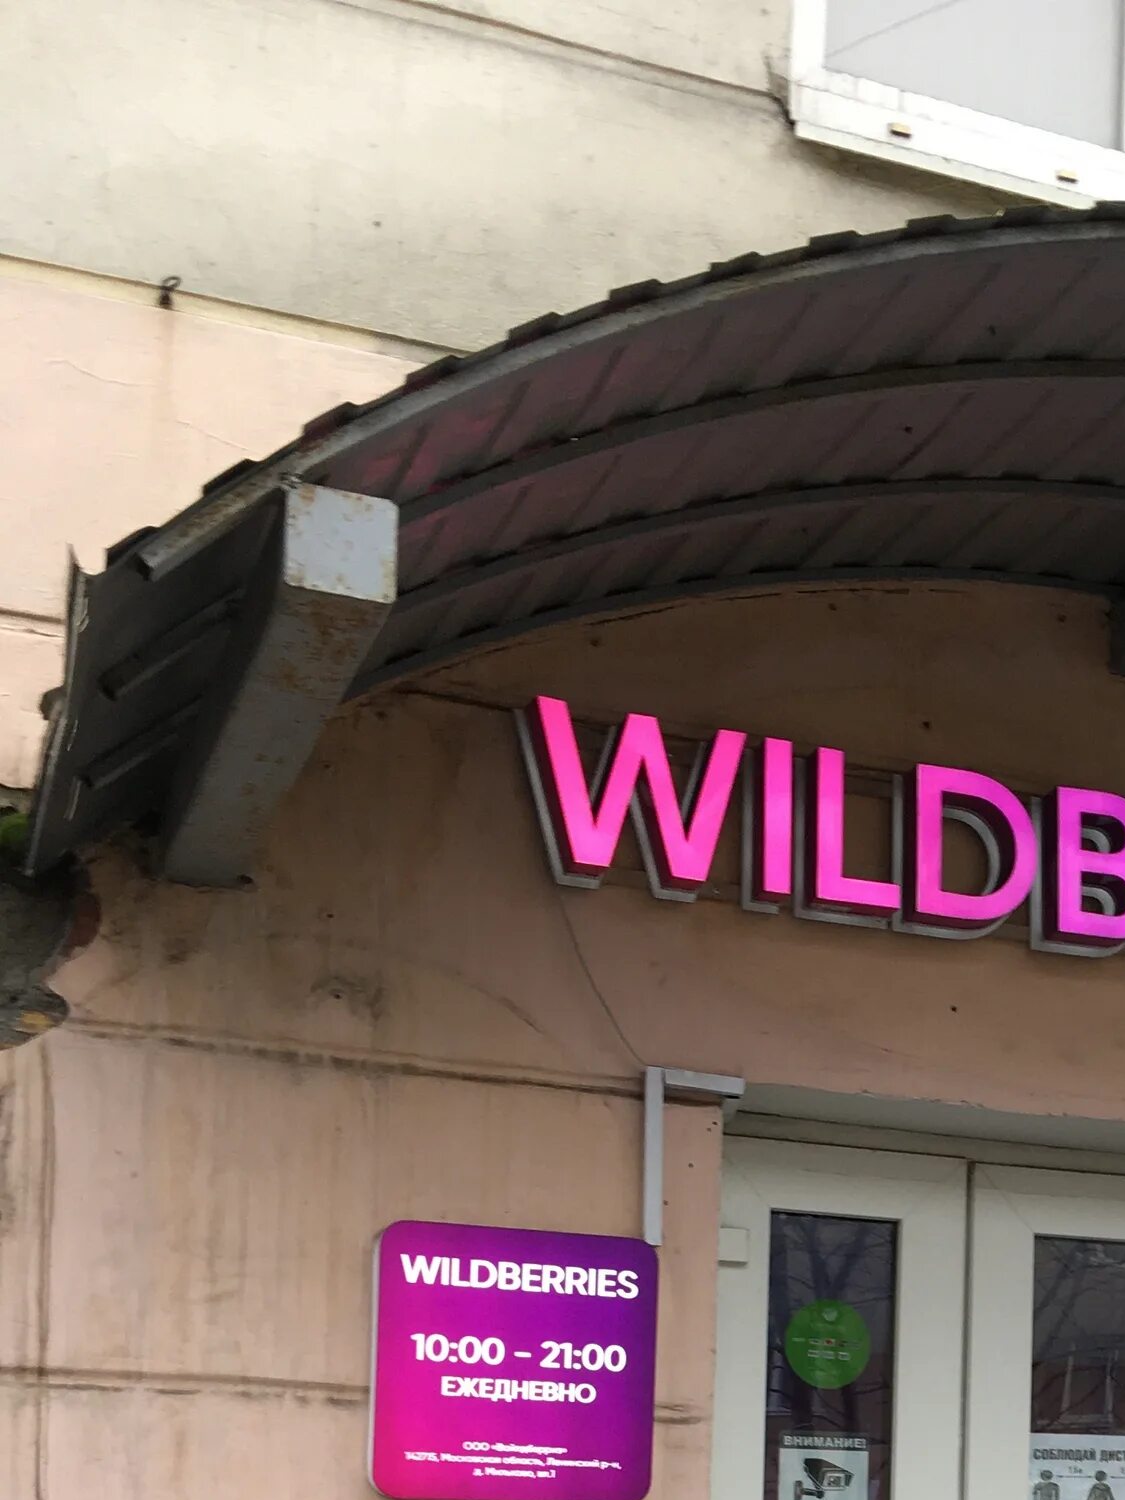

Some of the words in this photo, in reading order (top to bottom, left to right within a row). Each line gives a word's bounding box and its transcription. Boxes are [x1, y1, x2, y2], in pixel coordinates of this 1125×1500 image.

[400, 1253, 640, 1299] WILDBERRIES
[410, 1333, 506, 1366] 10:00
[539, 1340, 627, 1373] 21:00
[440, 1375, 597, 1404] ЕЖЕДНЕВНО
[462, 1441, 490, 1451] ООО
[783, 1434, 867, 1449] ВНИМАНИЕ!
[1032, 1448, 1097, 1461] СОБЛЮДАЙ
